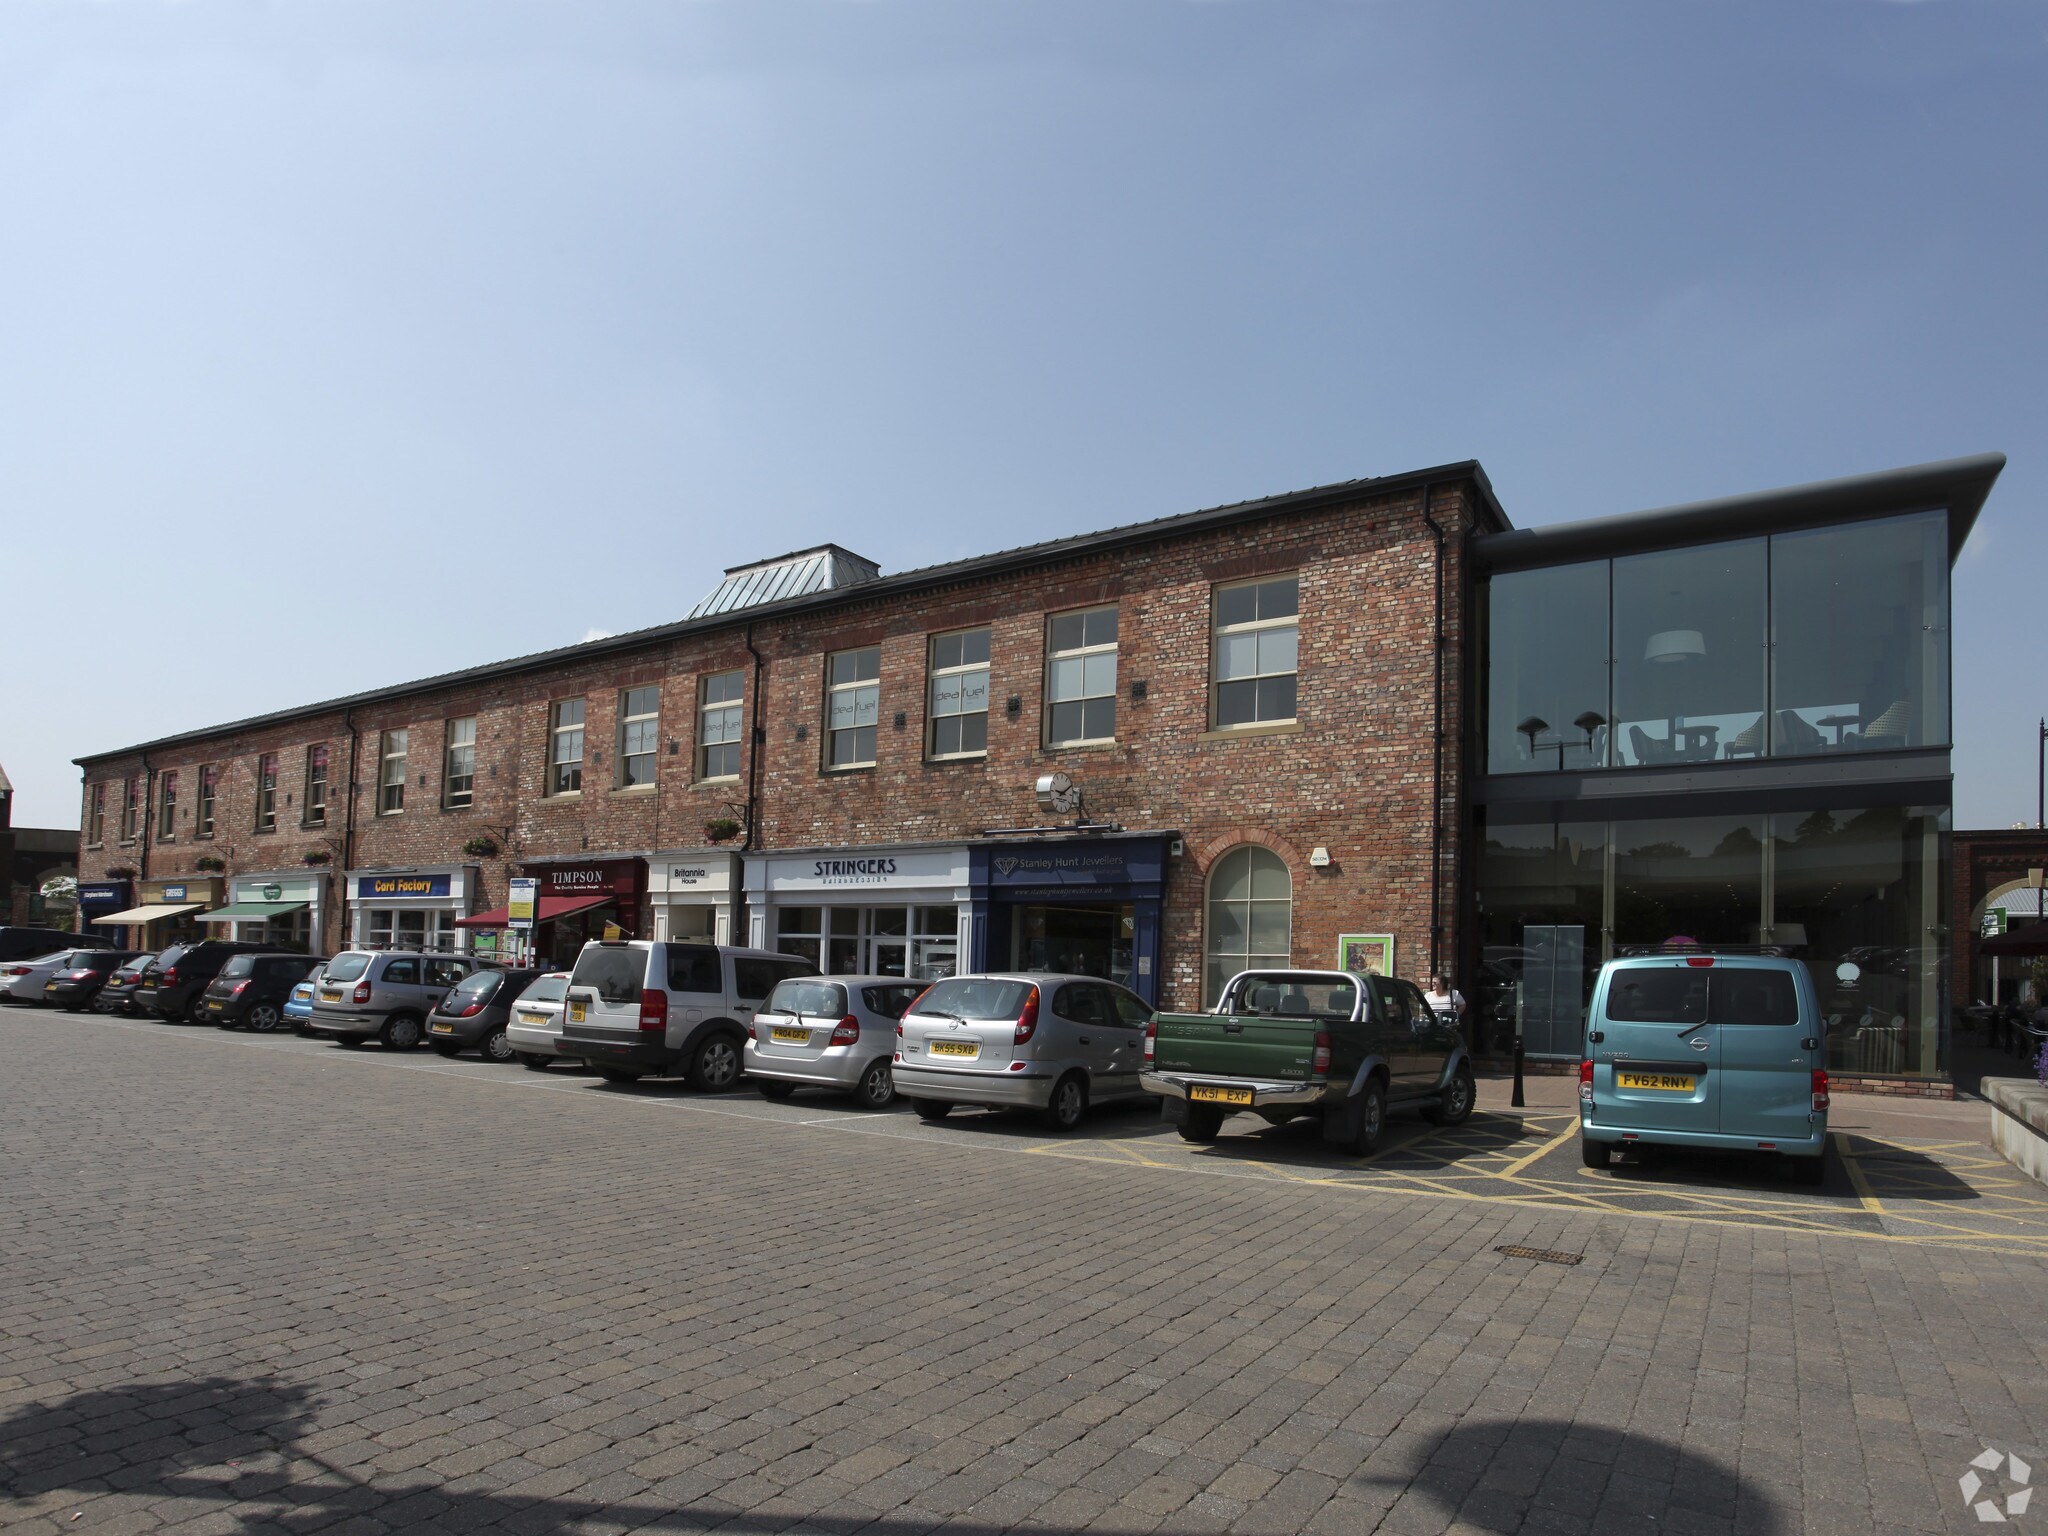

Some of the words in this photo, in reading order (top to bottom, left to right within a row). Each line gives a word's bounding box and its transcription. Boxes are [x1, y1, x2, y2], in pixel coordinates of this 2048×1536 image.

[814, 858, 897, 876] STRINGERS
[1019, 858, 1053, 869] Stanley
[1055, 857, 1079, 867] Hunt
[1081, 855, 1123, 866] Jewellers
[551, 870, 603, 884] TIMPSON
[674, 867, 706, 878] Britannia
[165, 888, 184, 897] GREGGS
[375, 879, 395, 893] Card
[397, 879, 432, 894] Factory
[774, 1029, 791, 1038] FR04
[793, 1030, 807, 1039] GFZ
[934, 1043, 955, 1053] BK55
[957, 1044, 975, 1054] SXD
[1623, 1074, 1659, 1087] FV62
[1661, 1076, 1689, 1088] RNY
[1194, 1086, 1219, 1099] YK51
[1226, 1089, 1249, 1101] EXP
